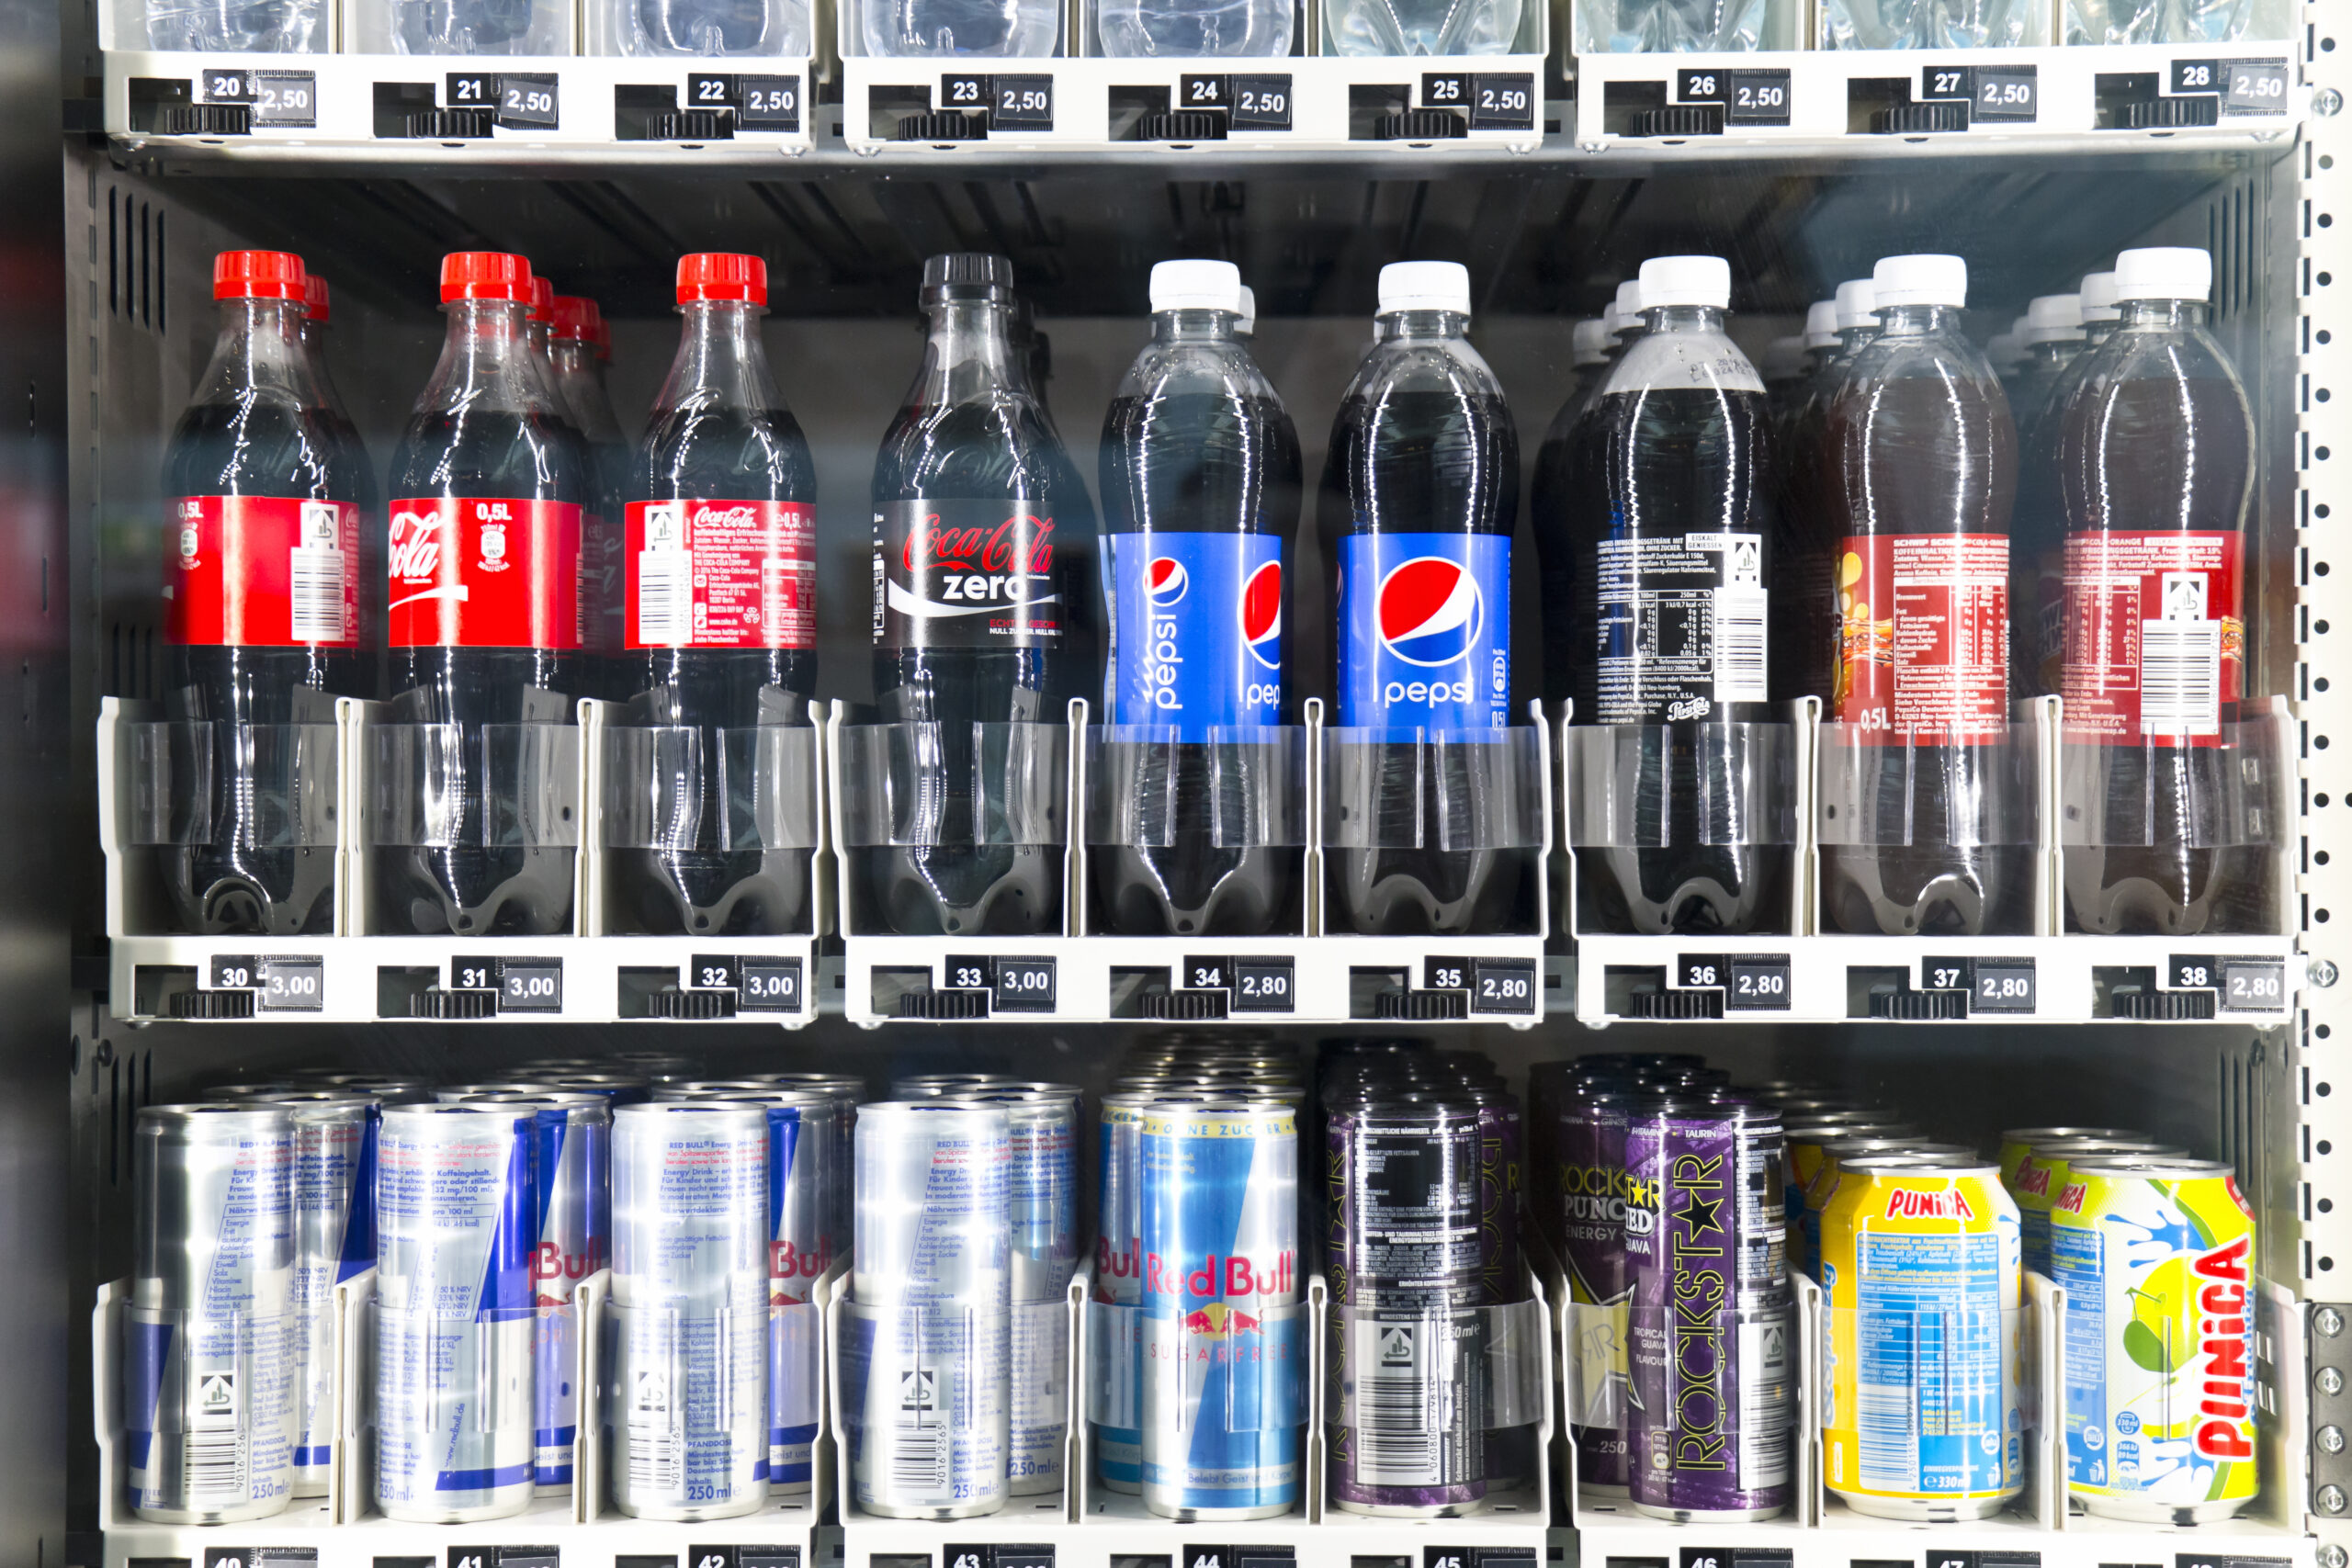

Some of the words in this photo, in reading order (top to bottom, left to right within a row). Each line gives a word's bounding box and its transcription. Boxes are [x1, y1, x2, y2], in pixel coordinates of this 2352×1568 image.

[1690, 76, 1714, 95] 26
[1935, 73, 1960, 92] 27
[2183, 67, 2209, 85] 28
[214, 77, 240, 96] 20
[458, 81, 481, 99] 21
[699, 81, 724, 100] 22
[954, 81, 978, 99] 23
[1193, 81, 1217, 99] 24
[1434, 81, 1458, 99] 25
[1984, 83, 2030, 104] 2,50
[2236, 76, 2282, 96] 2,50
[264, 90, 307, 108] 2,50
[508, 90, 551, 112] 2,50
[750, 91, 794, 109] 2,50
[1003, 91, 1046, 111] 2,50
[1241, 92, 1284, 113] 2,50
[1482, 90, 1525, 110] 2,50
[1738, 87, 1781, 107] 2,50
[477, 502, 513, 524] 0,5L
[694, 506, 757, 528] Coca-Cola
[903, 513, 1056, 573] Coca-Cola
[943, 575, 1027, 600] zero
[1860, 706, 1891, 734] 0,5L
[222, 968, 247, 987] 30
[462, 969, 486, 987] 31
[703, 968, 727, 986] 32
[956, 968, 981, 987] 33
[1004, 972, 1047, 990] 3,00
[1195, 968, 1220, 986] 34
[1436, 968, 1460, 987] 35
[1690, 966, 1715, 985] 36
[1739, 975, 1782, 994] 2,80
[1934, 969, 1959, 987] 37
[2181, 967, 2207, 986] 38
[272, 976, 315, 996] 3,00
[511, 977, 554, 997] 3,00
[750, 976, 793, 996] 3,00
[1243, 976, 1286, 997] 2,80
[1483, 979, 1526, 998] 2,80
[1984, 978, 2028, 998] 2,80
[2233, 976, 2278, 996] 2,80
[1163, 1123, 1208, 1136] ONE
[1219, 1123, 1283, 1136] ZUCER
[1685, 1128, 1717, 1139] TAURIN
[669, 1141, 684, 1149] RED
[937, 1140, 951, 1148] RED
[663, 1168, 689, 1178] Energy
[693, 1168, 713, 1176] Drink
[931, 1168, 957, 1177] Energy
[689, 1184, 707, 1192] nicht
[923, 1218, 947, 1227] Energie
[1566, 1224, 1617, 1242] ENERGY
[537, 1235, 603, 1280] Bull
[1100, 1236, 1140, 1280] Bul
[1147, 1252, 1216, 1298] Red
[1225, 1250, 1291, 1298] Bull
[1462, 1325, 1473, 1337] ml
[1150, 1343, 1287, 1363] SUGARFREE
[2117, 1418, 2129, 1427] 330
[937, 1424, 946, 1451] 2565
[687, 1450, 729, 1460] Mindestens
[1428, 1427, 1437, 1469] 060800
[1600, 1440, 1626, 1456] 250
[672, 1459, 681, 1486] 9016
[687, 1459, 701, 1467] bar
[937, 1456, 946, 1484] 9016
[1011, 1459, 1035, 1476] 250
[1037, 1457, 1050, 1474] ml
[1454, 1448, 1463, 1483] Schmeckt
[234, 1461, 245, 1488] 9016
[1188, 1472, 1219, 1484] Belebt
[253, 1483, 274, 1499] 250
[687, 1483, 715, 1501] 250
[717, 1482, 731, 1498] ml
